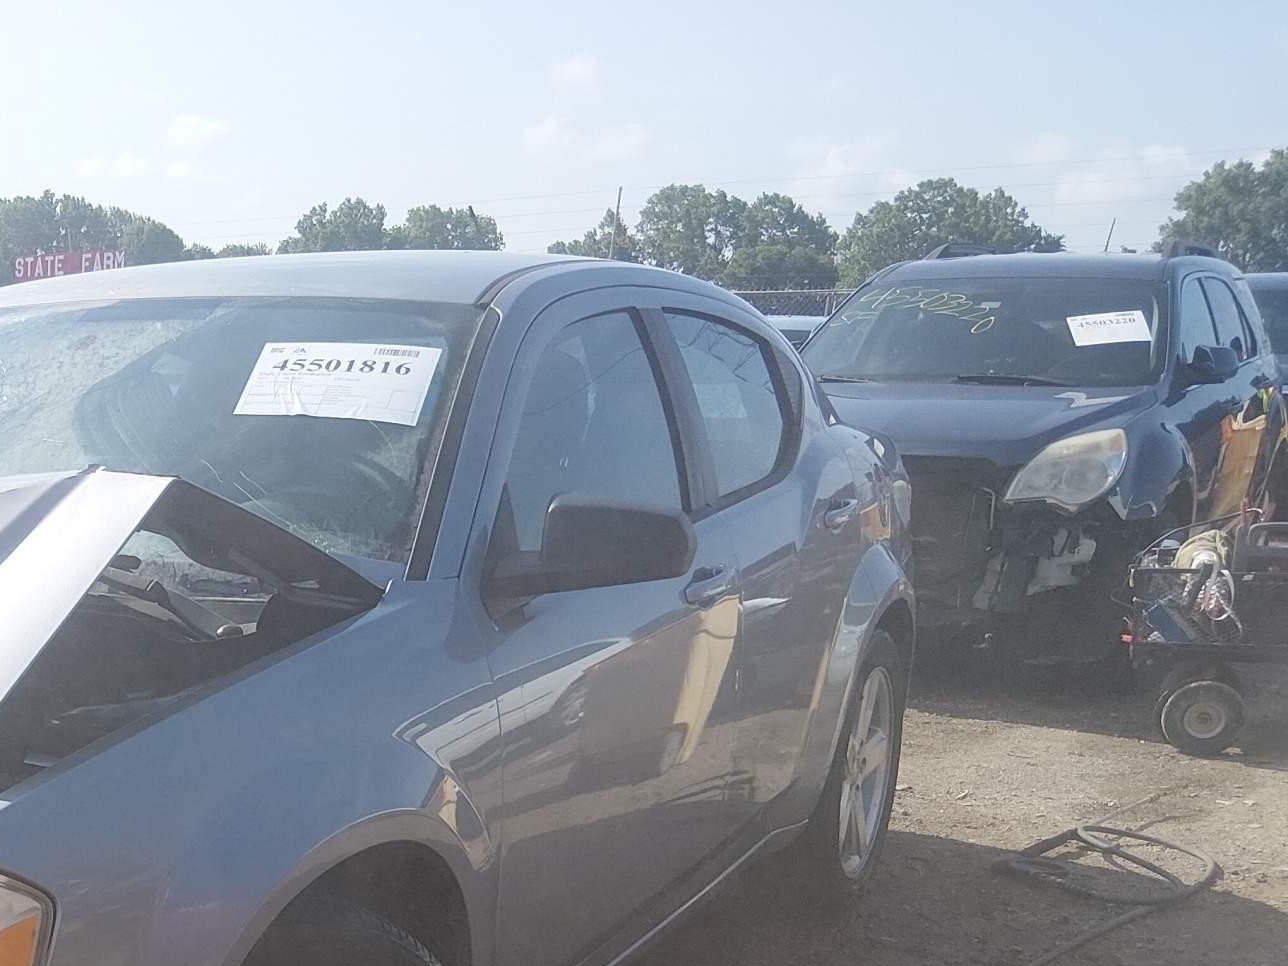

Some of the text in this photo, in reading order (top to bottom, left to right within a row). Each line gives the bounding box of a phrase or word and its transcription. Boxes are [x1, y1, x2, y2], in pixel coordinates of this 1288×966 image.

[15, 250, 125, 278] STATE FARM
[272, 358, 412, 376] 45501816
